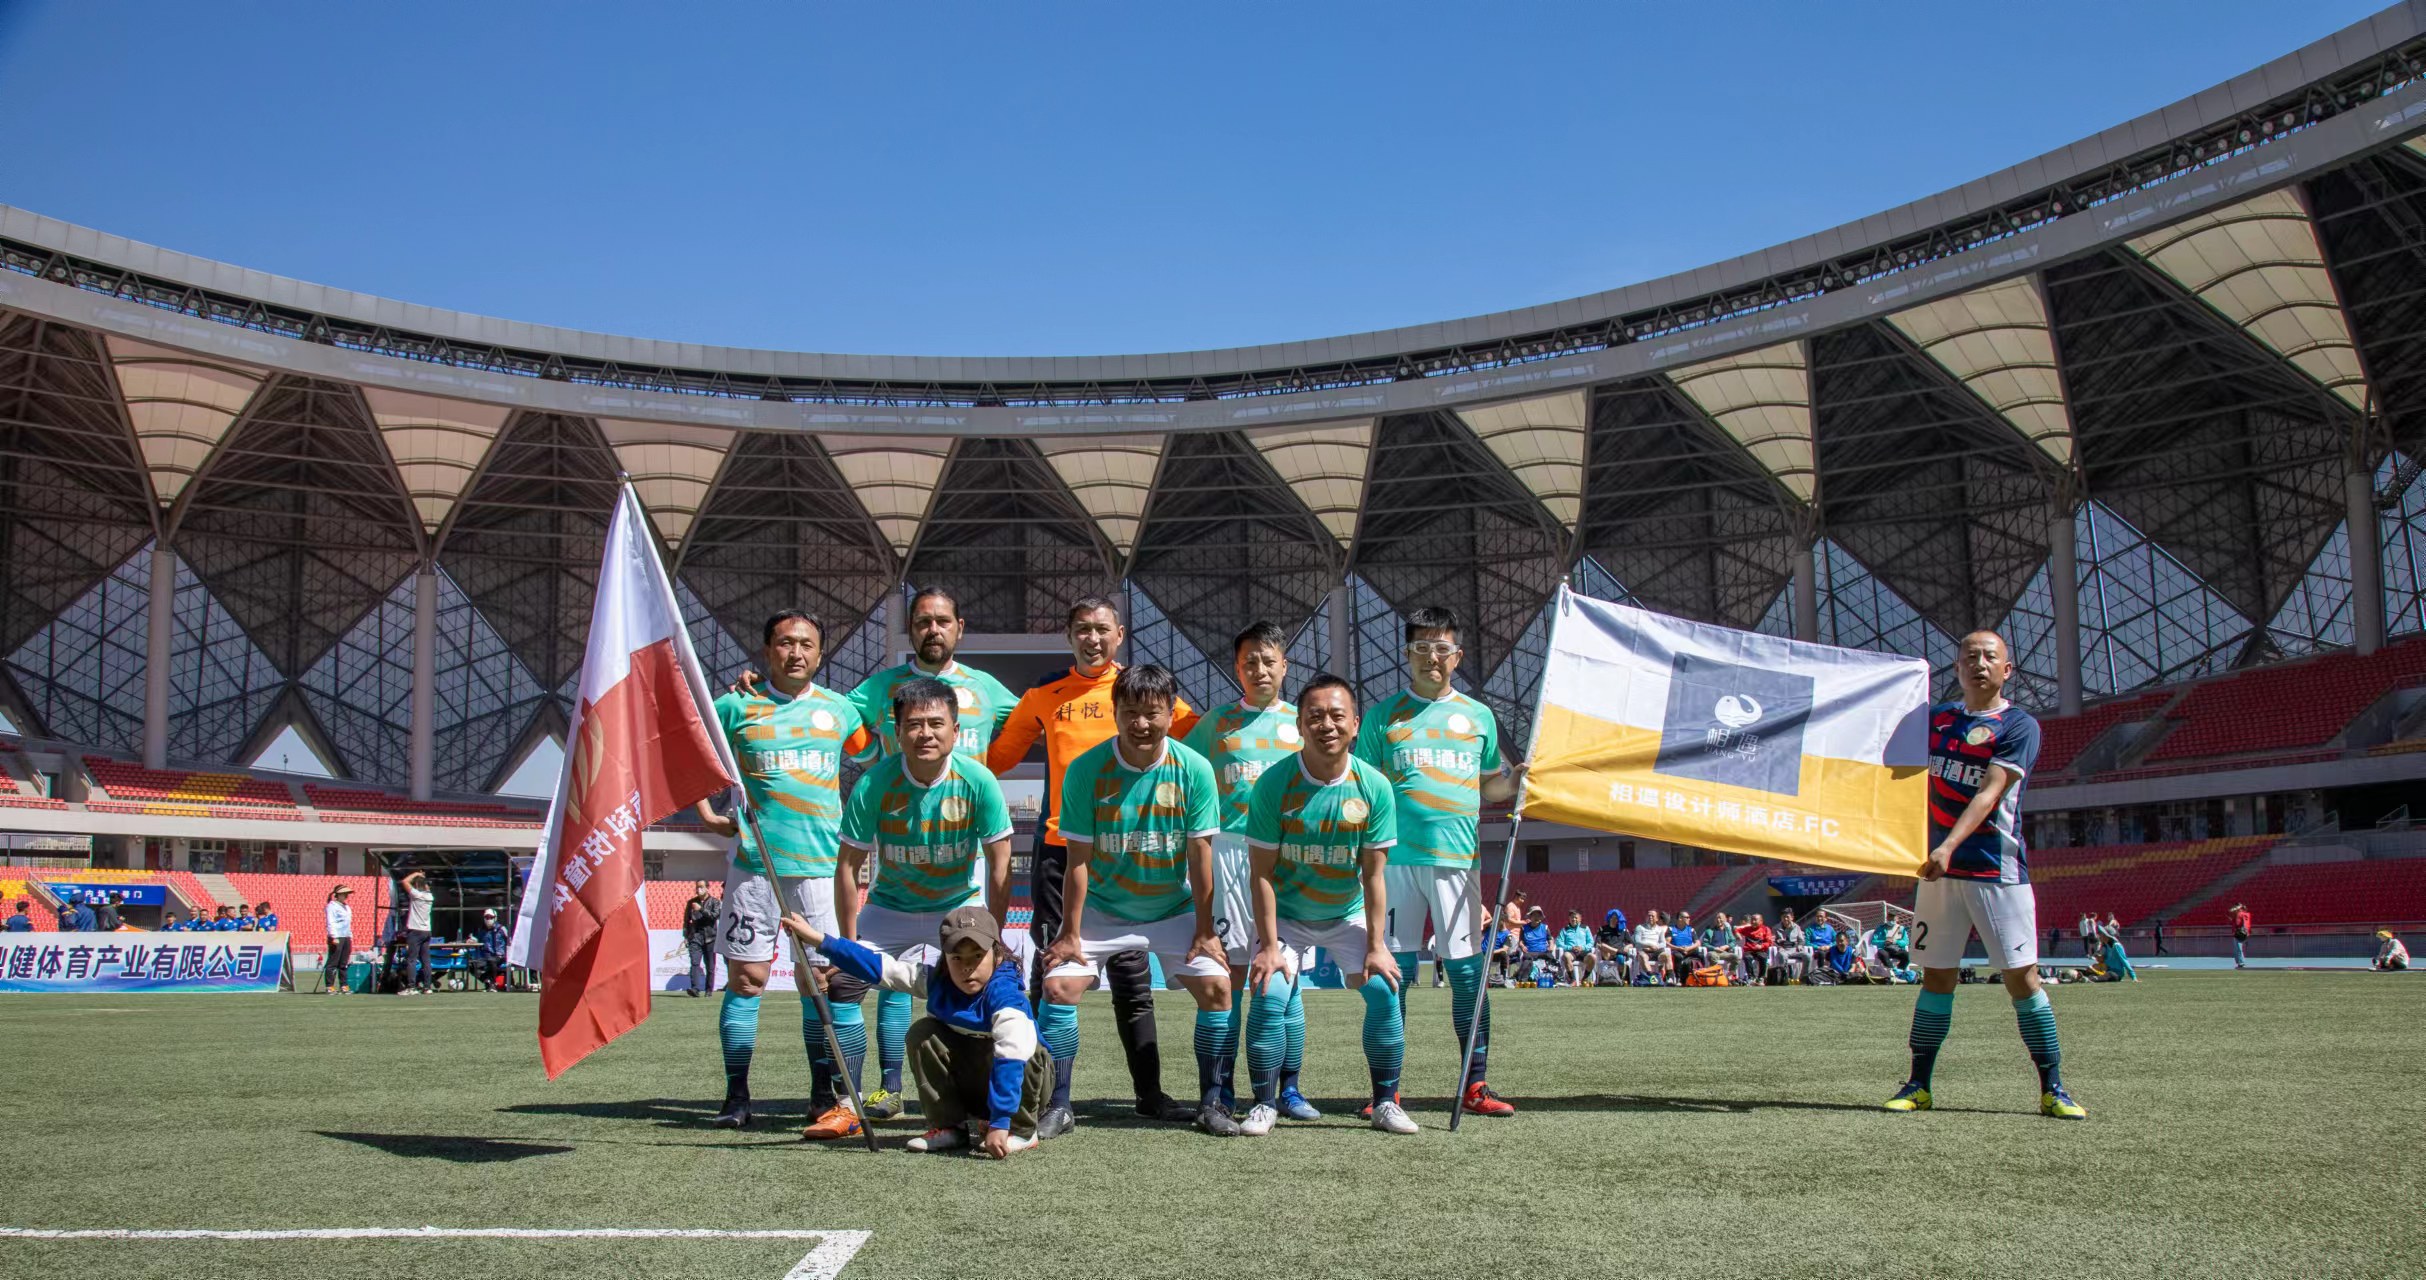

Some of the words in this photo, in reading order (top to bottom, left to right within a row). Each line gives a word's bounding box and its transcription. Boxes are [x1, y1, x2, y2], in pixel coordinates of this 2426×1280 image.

[1055, 701, 1113, 721] 科悦
[1224, 761, 1278, 785] 相遇
[1392, 748, 1474, 773] 相遇酒店
[725, 912, 756, 946] 25
[1212, 916, 1231, 948] 2
[1914, 921, 1929, 951] 2
